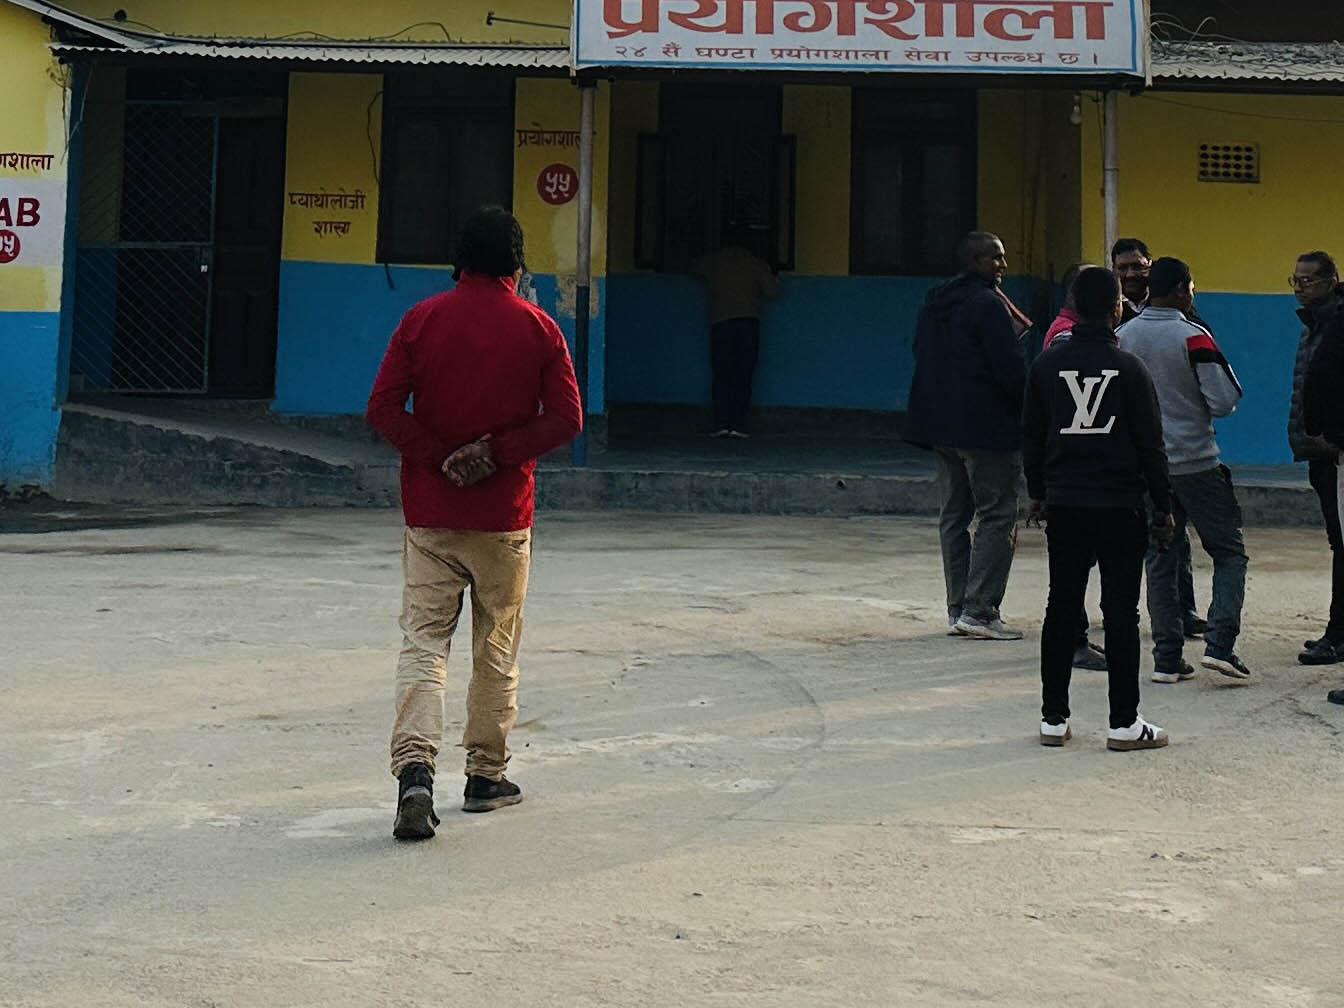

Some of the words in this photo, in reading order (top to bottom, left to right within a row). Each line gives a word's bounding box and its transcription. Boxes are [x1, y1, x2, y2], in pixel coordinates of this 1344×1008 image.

[615, 45, 647, 58] २४
[695, 47, 757, 59] घण्टा
[770, 45, 891, 60] प्रयोगशाला
[904, 46, 952, 61] सेवा
[1058, 52, 1080, 65] छ
[544, 172, 570, 200] ५५
[1059, 369, 1119, 434] LV
